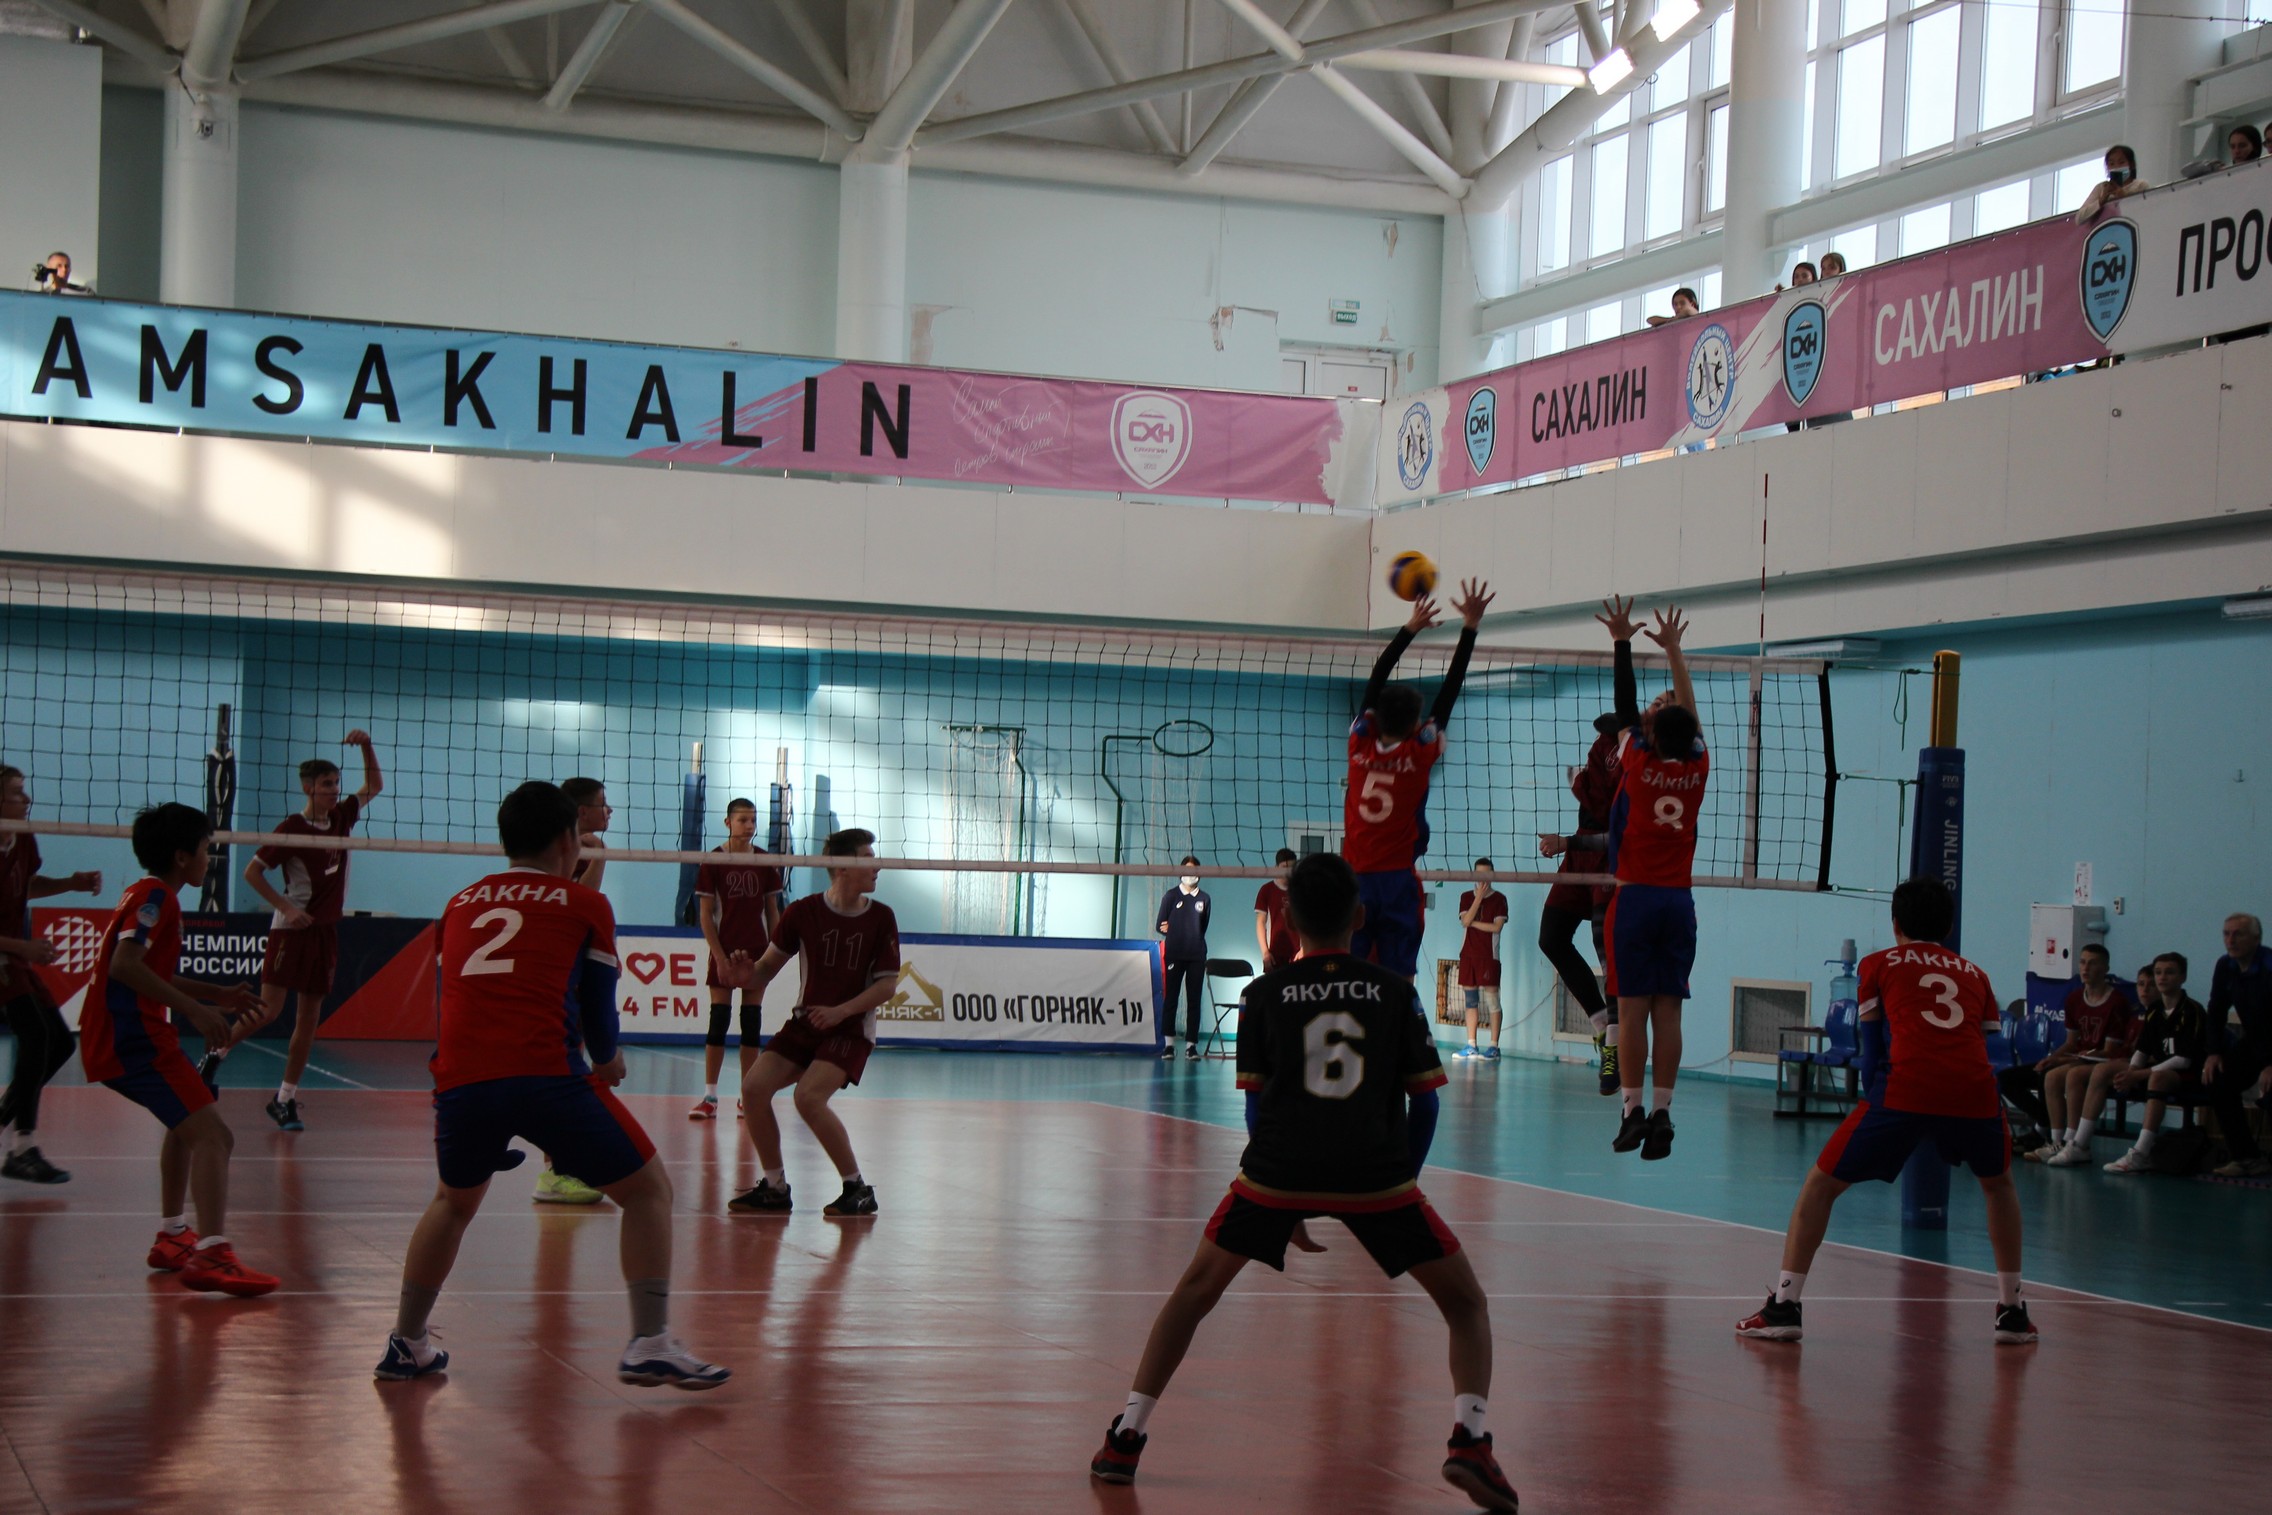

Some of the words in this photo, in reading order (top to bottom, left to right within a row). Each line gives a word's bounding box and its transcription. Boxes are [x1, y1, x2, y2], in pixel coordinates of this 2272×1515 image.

[1875, 265, 2045, 365] САХАЛИН
[1532, 366, 1646, 443] САХАЛИН
[1358, 771, 1396, 824] 5
[453, 883, 569, 908] SAKHA
[726, 870, 760, 899] 20
[460, 906, 524, 977] 2
[822, 928, 863, 971] 11
[179, 955, 265, 975] РОССИИ
[1885, 948, 1980, 979] SAKHA
[622, 996, 640, 1017] 4
[652, 996, 699, 1018] FM
[952, 993, 998, 1021] ООО
[1281, 981, 1381, 1003] ЯКУТСК
[1918, 972, 1965, 1030] 3
[875, 1004, 943, 1020] РНЯК-1
[2078, 1015, 2103, 1044] 17
[1302, 1010, 1367, 1101] 6
